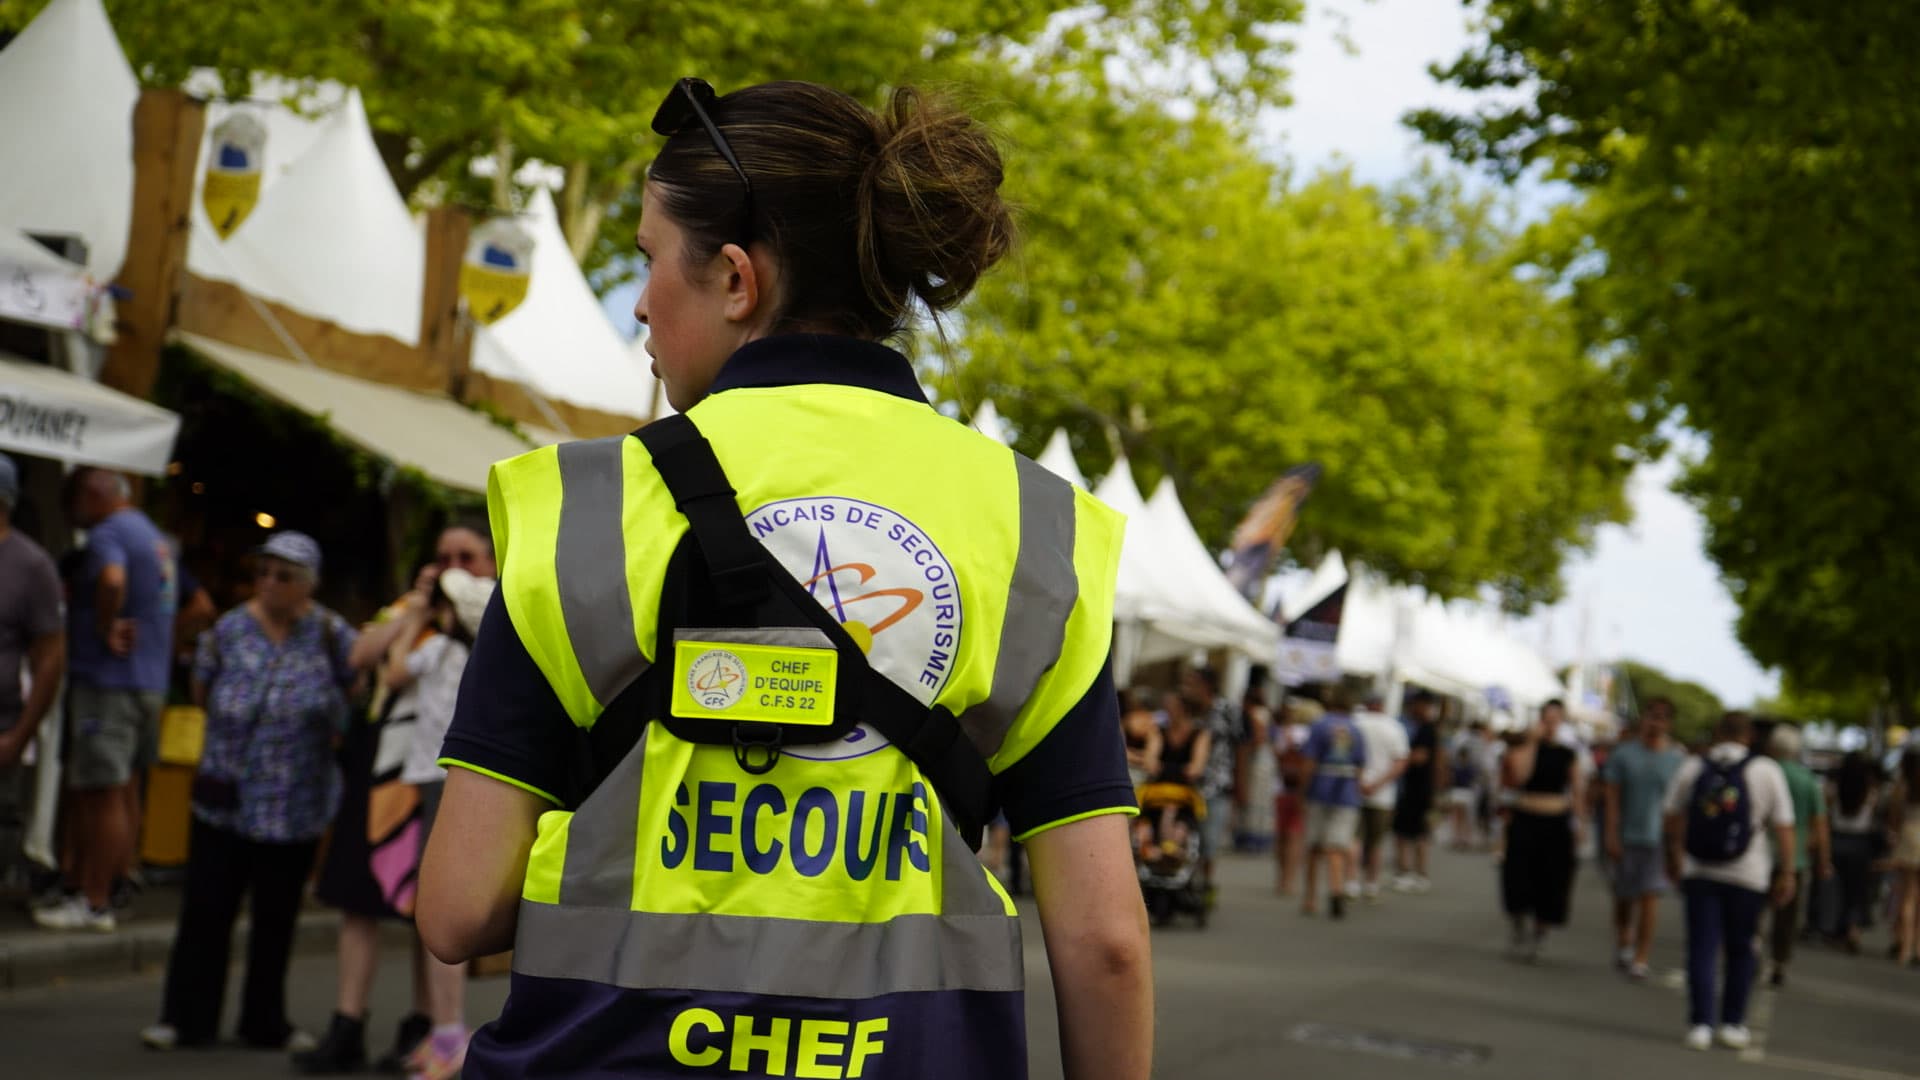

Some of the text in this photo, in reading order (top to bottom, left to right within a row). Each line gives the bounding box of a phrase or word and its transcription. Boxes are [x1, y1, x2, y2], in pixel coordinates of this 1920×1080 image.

[753, 504, 954, 690] NCAIS DE SECOURISME
[771, 660, 811, 675] CHEF
[755, 676, 823, 693] D'EQUIPE
[799, 697, 816, 710] 22
[668, 1007, 889, 1080] CHEF
